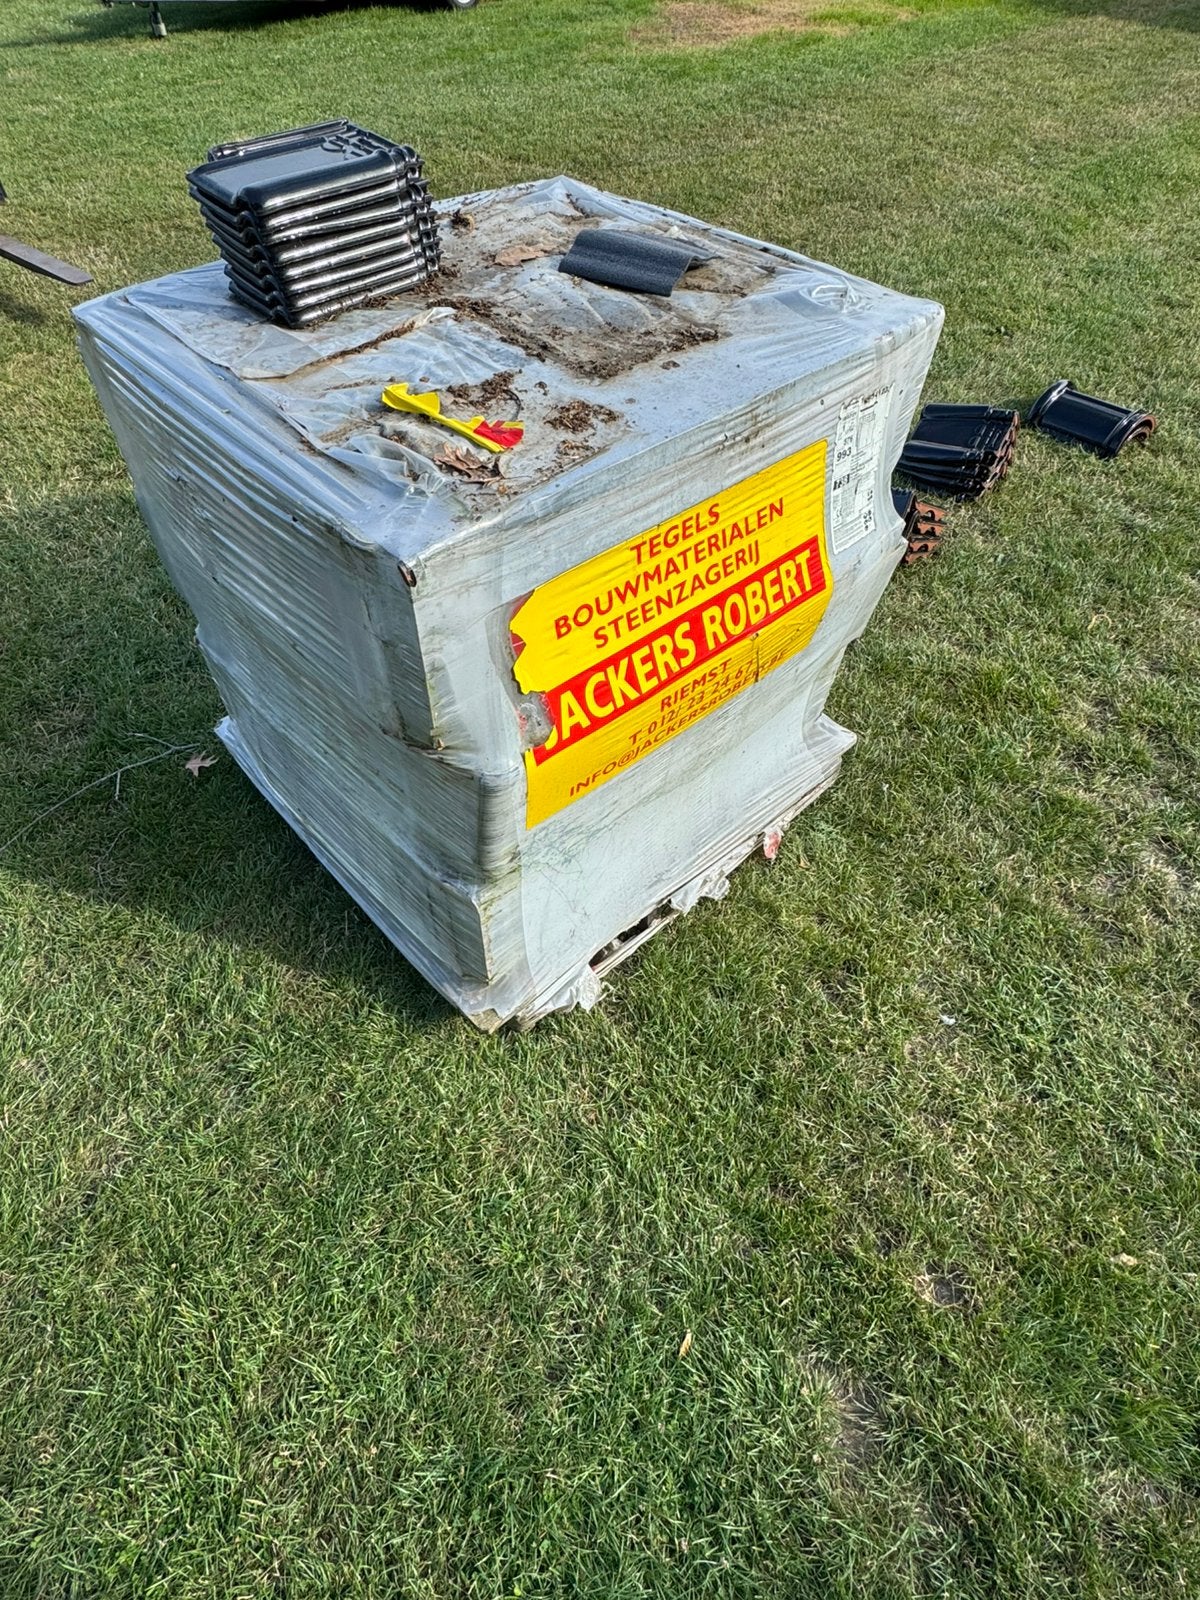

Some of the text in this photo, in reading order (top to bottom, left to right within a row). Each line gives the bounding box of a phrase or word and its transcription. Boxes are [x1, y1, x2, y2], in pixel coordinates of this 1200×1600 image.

[836, 446, 852, 463] 993
[630, 502, 722, 565] TEGELS
[554, 497, 785, 640] BOUWMATERIALEN
[594, 539, 761, 649] STEENZAGERIJ
[704, 547, 814, 651] ROBERT
[659, 657, 733, 713] RIEMST
[688, 692, 705, 711] 23
[711, 674, 729, 694] 24
[735, 659, 755, 679] 67
